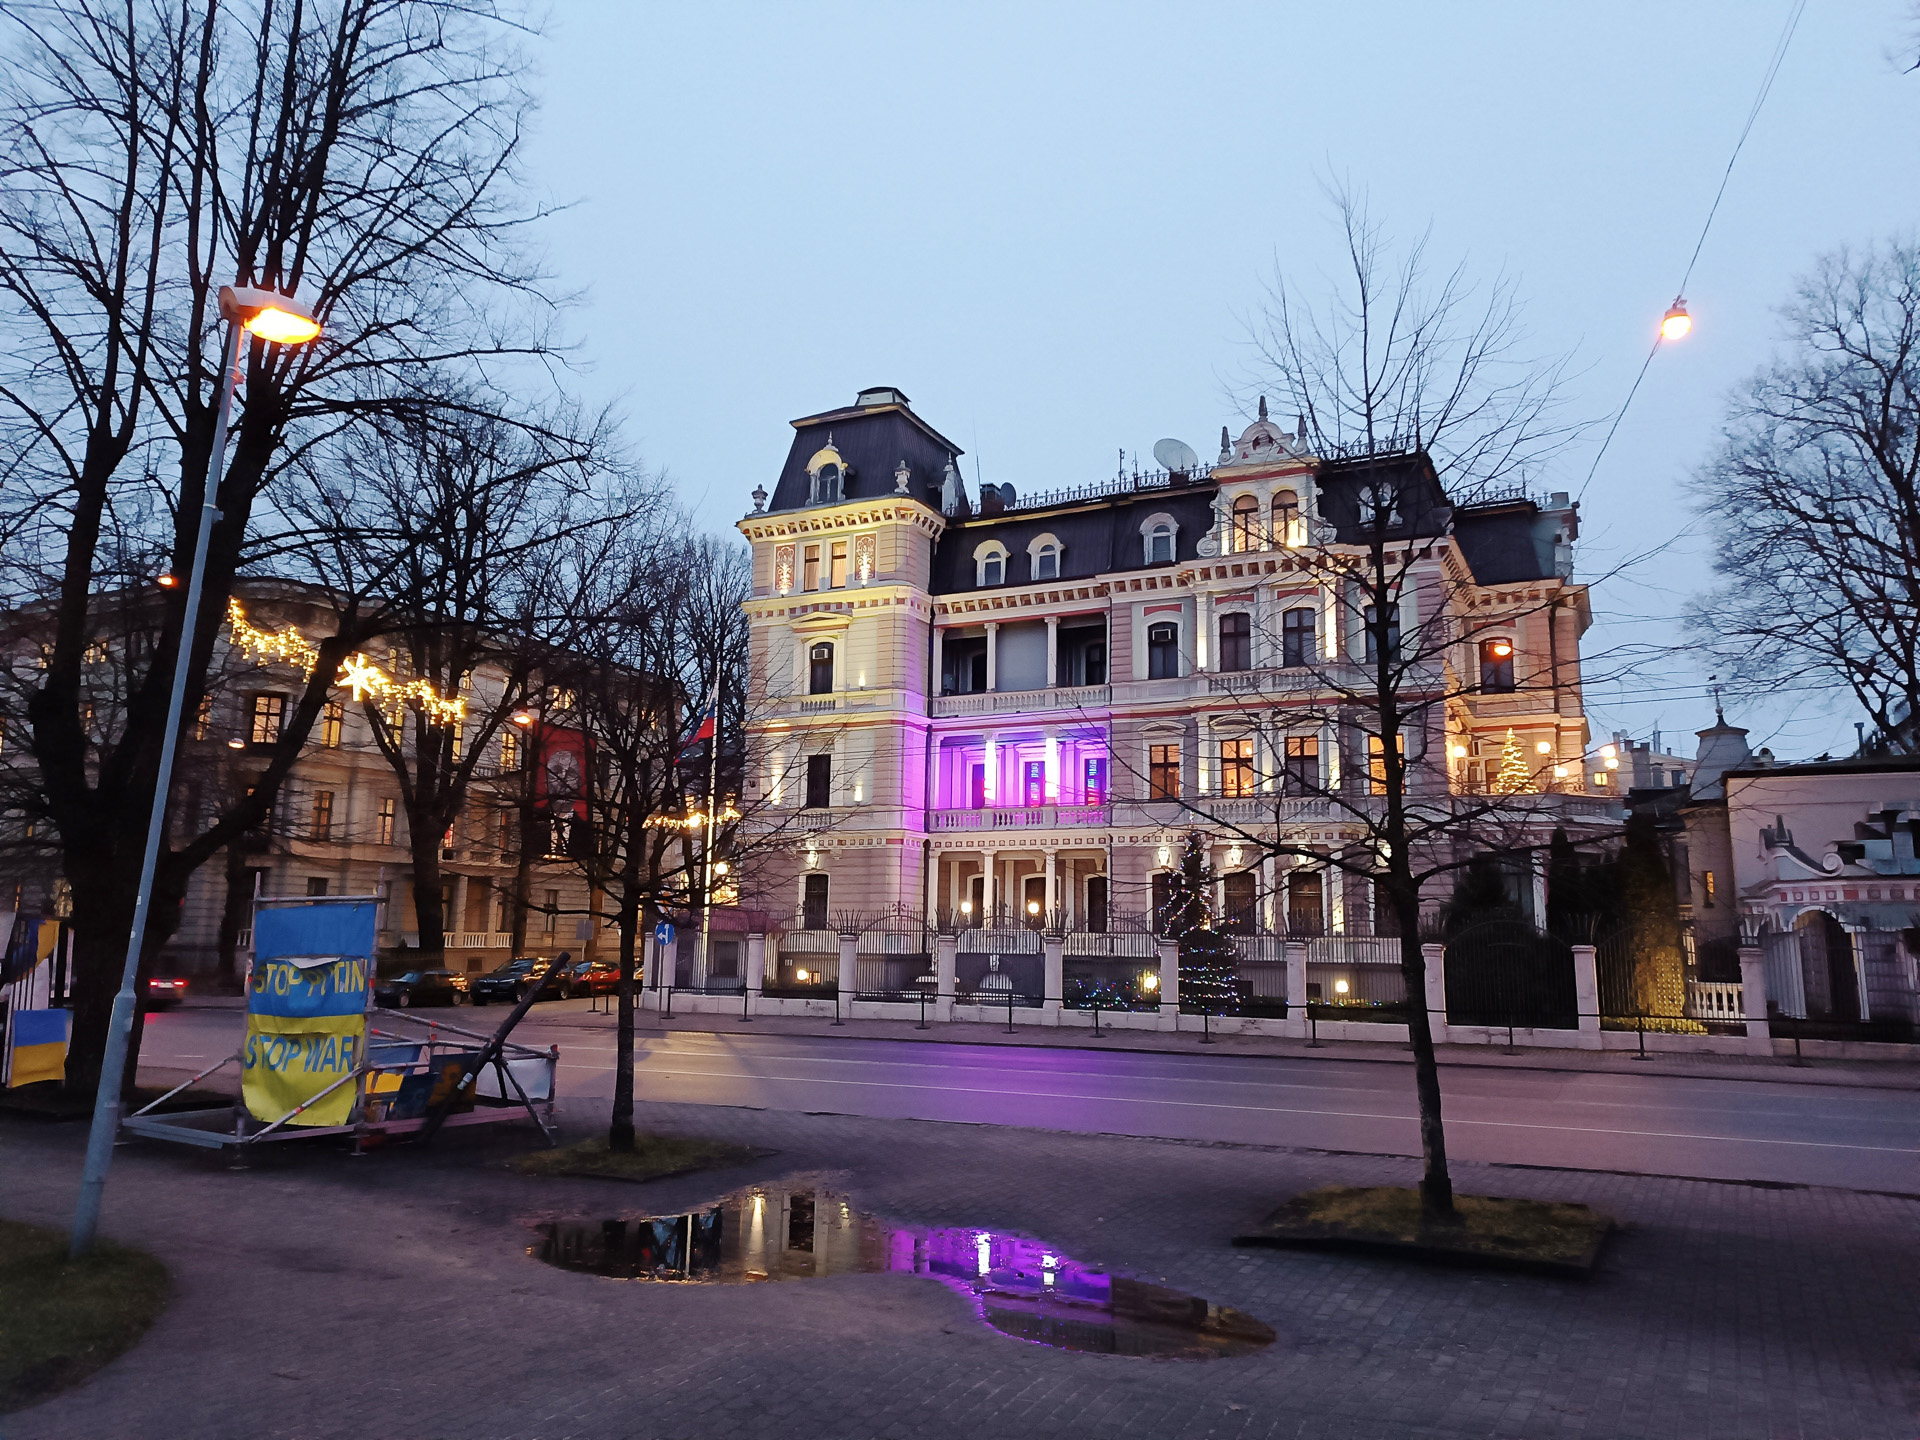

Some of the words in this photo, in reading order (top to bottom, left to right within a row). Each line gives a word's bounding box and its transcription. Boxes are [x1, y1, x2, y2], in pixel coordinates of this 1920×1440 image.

[254, 963, 304, 996] STOP
[245, 1034, 302, 1072] STOP
[303, 1035, 354, 1073] WAR
